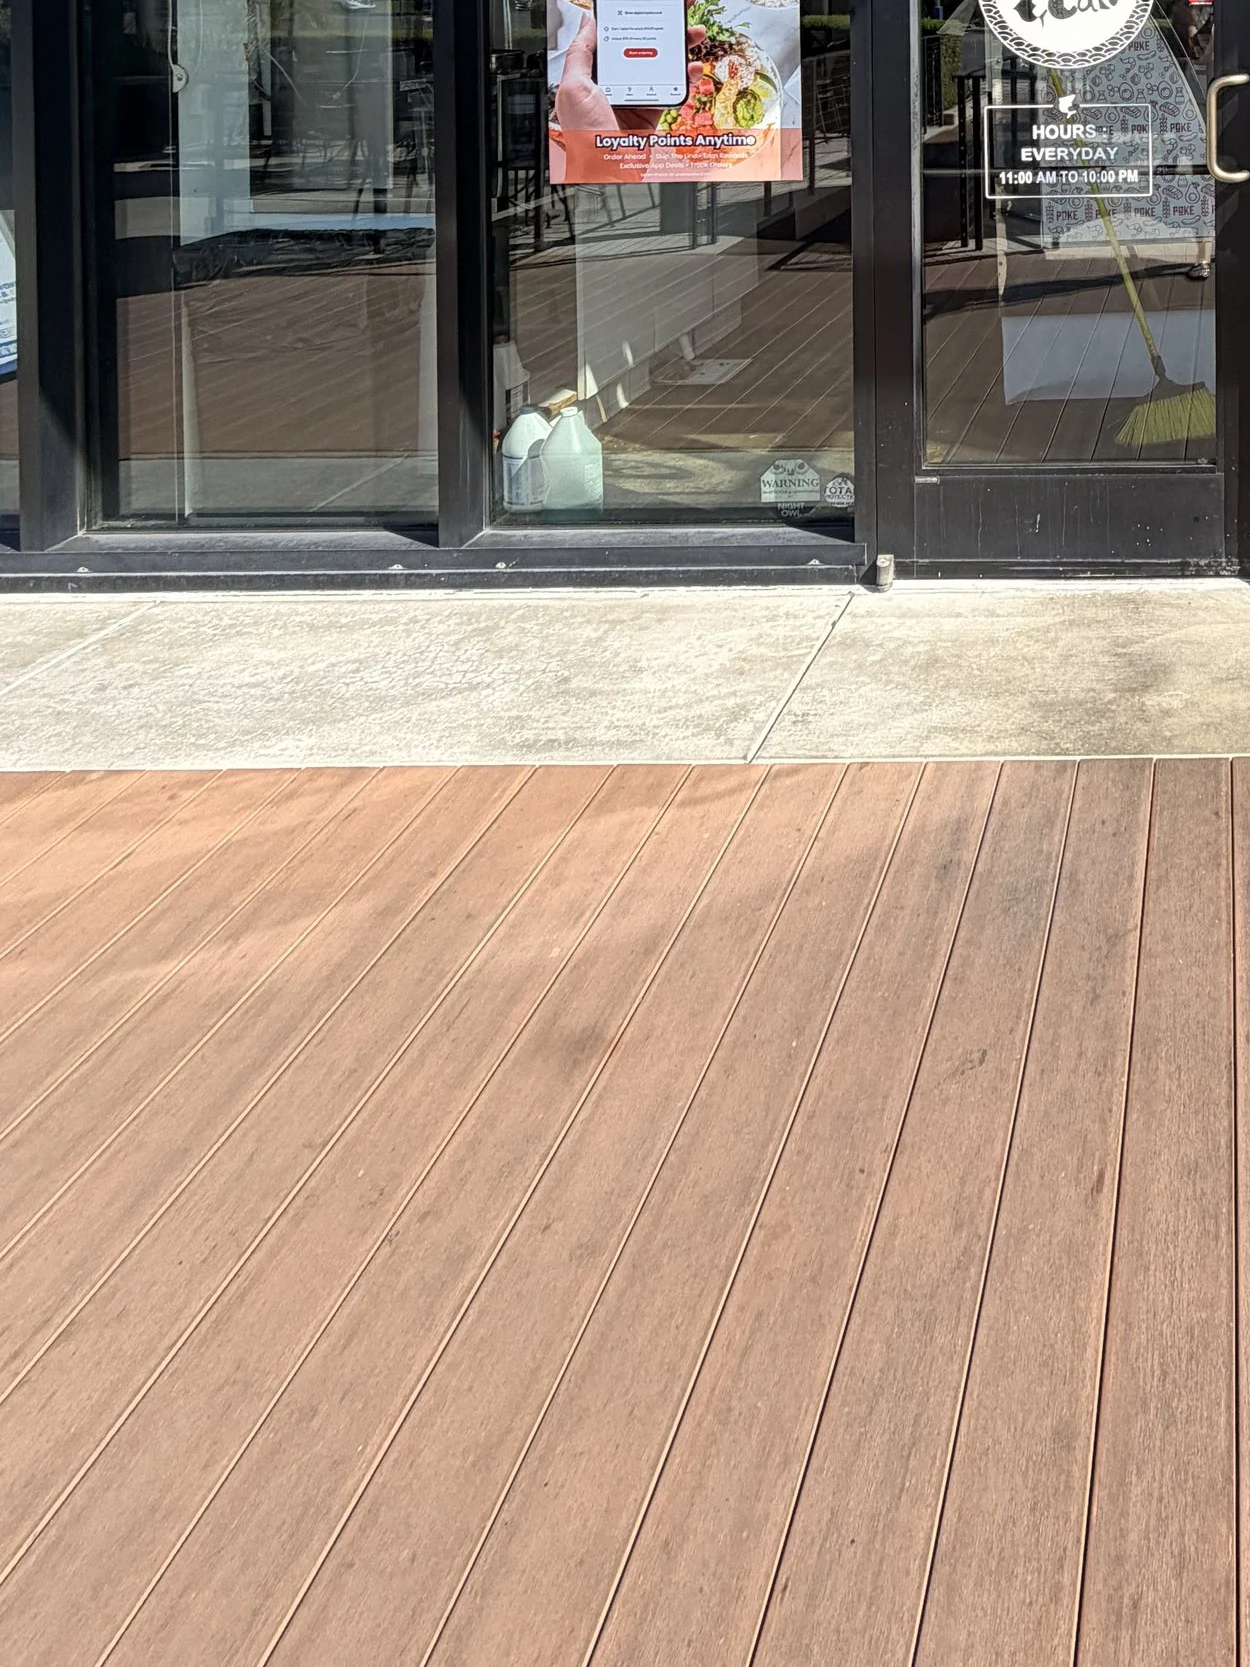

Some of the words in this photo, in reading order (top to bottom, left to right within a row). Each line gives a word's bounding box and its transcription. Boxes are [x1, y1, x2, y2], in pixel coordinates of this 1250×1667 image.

[1127, 40, 1151, 53] POKE
[1032, 124, 1097, 140] HOURS
[1169, 122, 1193, 133] POKE
[595, 134, 647, 153] Loyalty
[648, 132, 694, 147] Points
[694, 131, 757, 150] Anytime
[603, 153, 623, 161] Order
[624, 153, 647, 161] Ahead
[1020, 146, 1119, 162] EVERYDAY
[999, 171, 1033, 185] 11:00
[1035, 170, 1057, 184] AM
[1059, 170, 1079, 184] TO
[1081, 169, 1116, 184] 10:00
[1117, 169, 1139, 183] PM
[1056, 209, 1079, 221] POKE
[1133, 206, 1157, 218] POKE
[1172, 205, 1196, 216] POKE
[762, 478, 820, 488] WARNING
[781, 509, 801, 517] OWL
